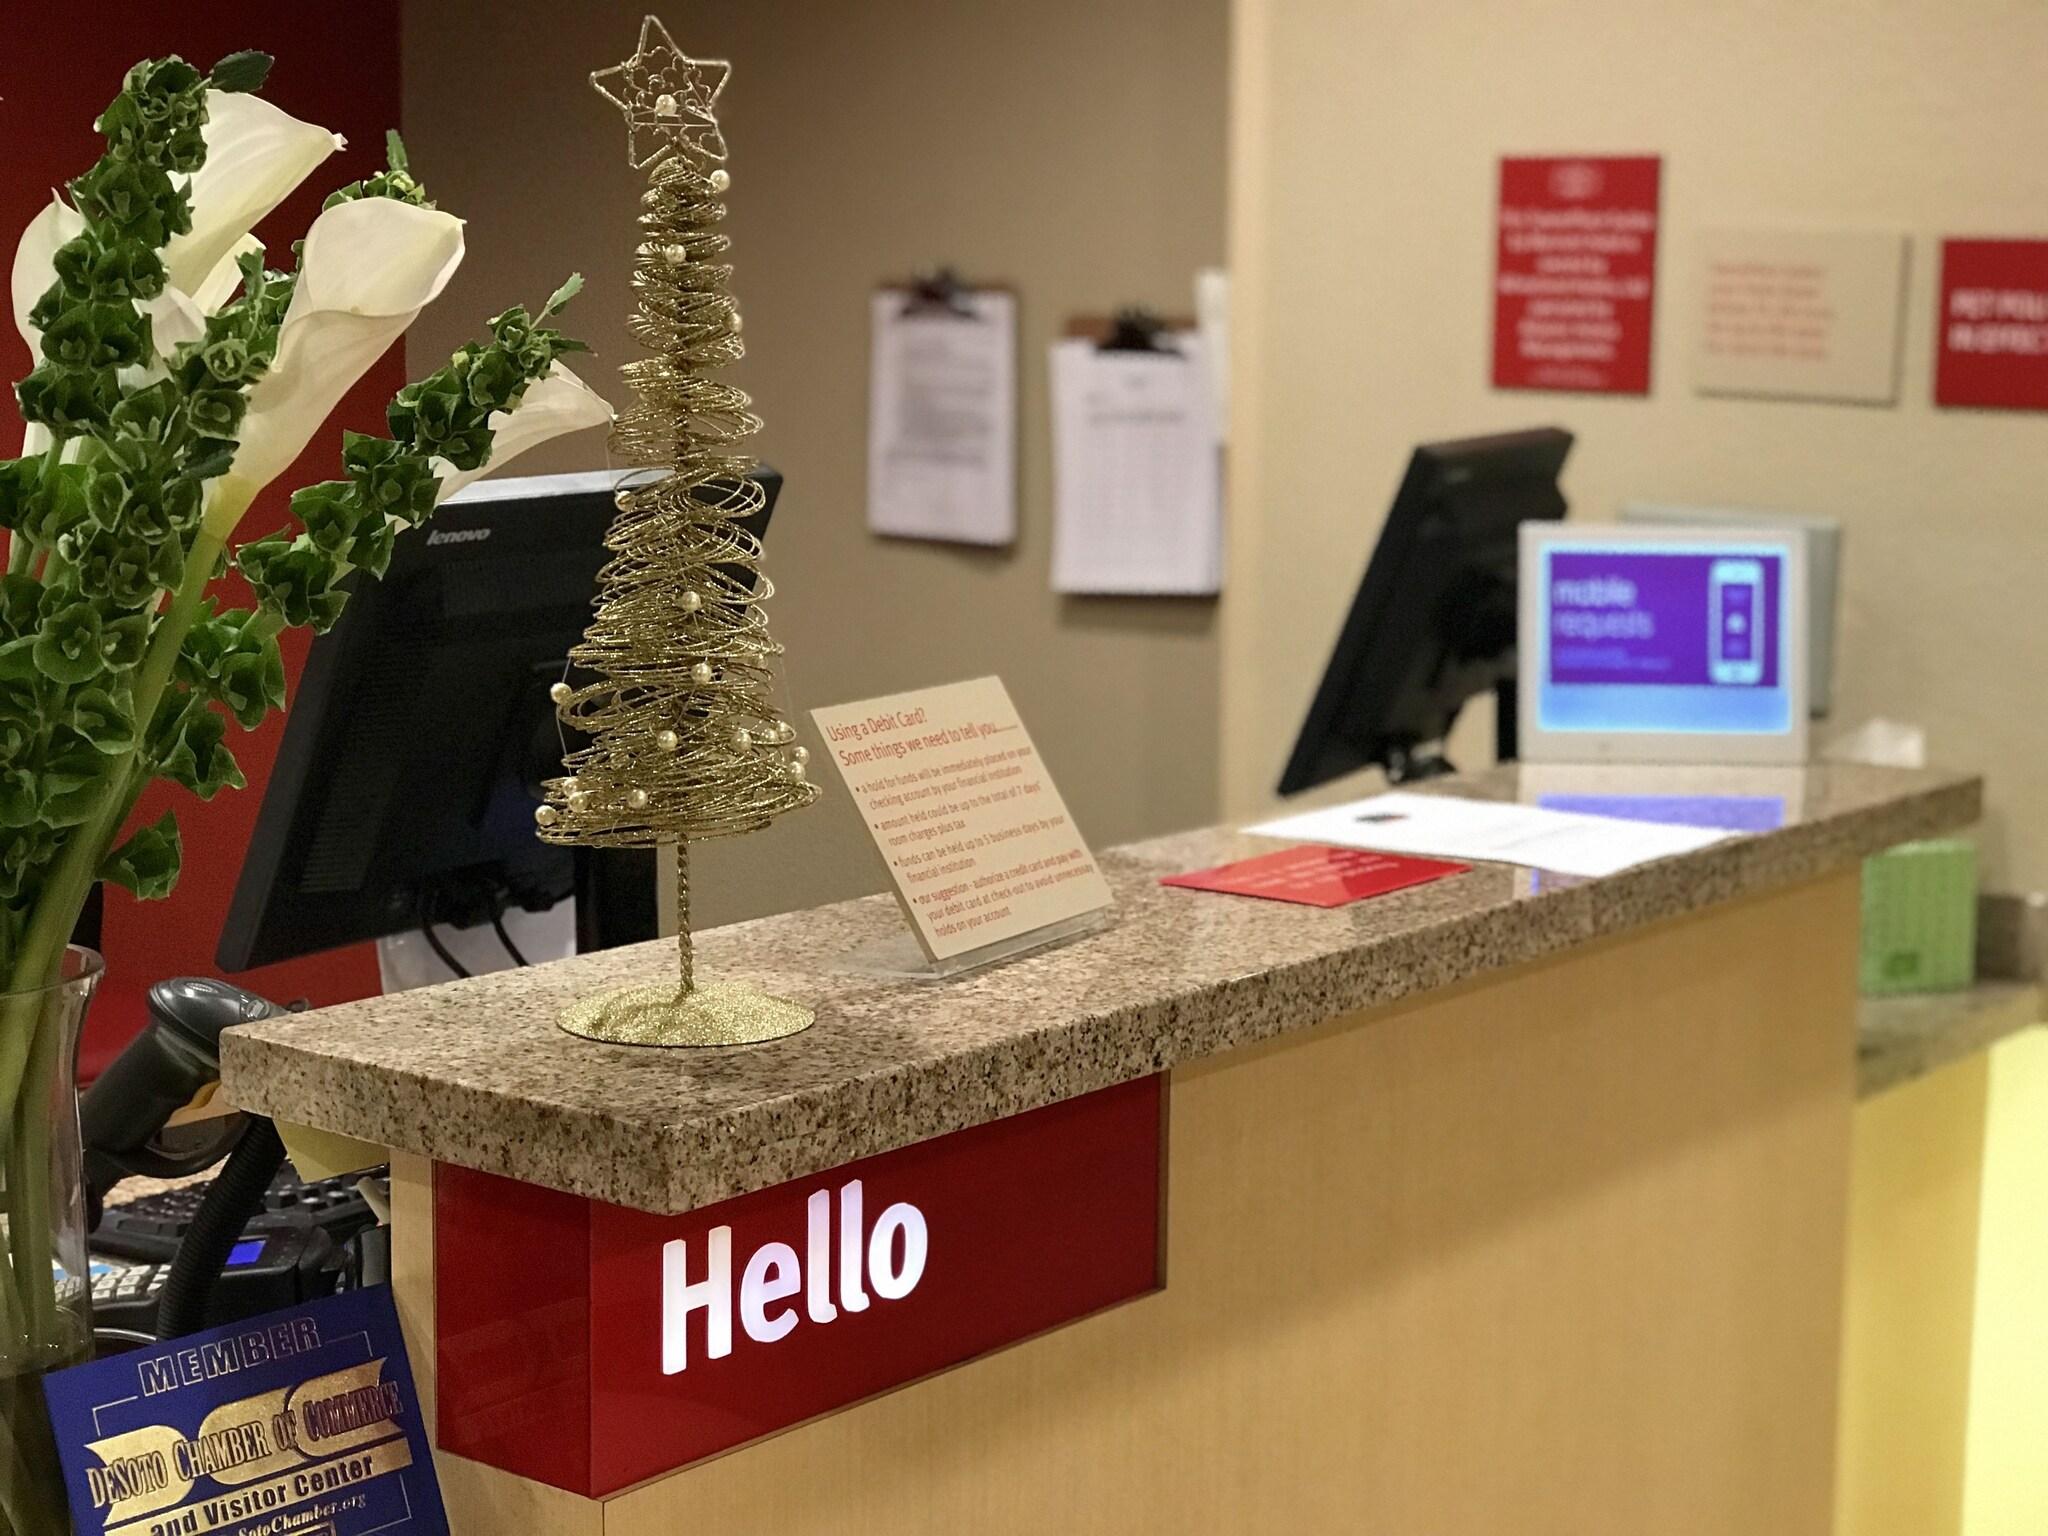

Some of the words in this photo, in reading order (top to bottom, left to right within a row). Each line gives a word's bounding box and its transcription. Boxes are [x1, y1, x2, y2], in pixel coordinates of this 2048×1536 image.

[426, 528, 491, 546] lenovo
[826, 724, 862, 742] Using
[860, 723, 870, 735] a
[867, 715, 898, 733] Debit
[896, 707, 927, 727] Card?
[839, 750, 873, 766] Some
[871, 742, 907, 759] things
[905, 738, 923, 751] we
[922, 731, 950, 747] need
[947, 730, 961, 742] to
[959, 723, 979, 740] tell
[866, 780, 886, 791] hold
[883, 777, 896, 788] for
[895, 773, 918, 785] funds
[930, 768, 942, 777] be
[984, 752, 1007, 765] placed
[1006, 750, 1017, 759] on
[1016, 747, 1031, 757] your
[870, 795, 904, 810] checking
[931, 786, 942, 795] by
[942, 782, 957, 794] your
[956, 773, 988, 787] financial
[988, 766, 1022, 780] institution
[881, 816, 910, 830] amount
[909, 811, 928, 822] held
[927, 805, 949, 819] could
[948, 804, 959, 813] be
[960, 801, 970, 811] up
[969, 799, 979, 808] to
[978, 796, 992, 805] the
[991, 791, 1009, 802] total
[888, 835, 908, 846] room
[909, 827, 938, 841] charges
[937, 823, 954, 835] plus
[953, 820, 966, 829] tax
[898, 855, 922, 867] funds
[921, 851, 935, 861] can
[935, 848, 947, 858] be
[946, 841, 965, 853] held
[965, 840, 976, 850] up
[974, 838, 985, 847] to
[989, 828, 1022, 843] business
[1022, 822, 1040, 834] days
[1038, 820, 1050, 829] by
[1049, 816, 1064, 827] your
[906, 867, 939, 883] financial
[940, 858, 976, 874] institution
[918, 894, 931, 905] our
[931, 884, 969, 901] suggestion
[973, 873, 1005, 889] authorize
[1009, 864, 1029, 878] credit
[1028, 860, 1044, 872] card
[1043, 856, 1057, 868] and
[1056, 855, 1069, 865] pay
[1068, 849, 1082, 860] with
[927, 909, 945, 923] your
[945, 902, 965, 916] debit
[965, 896, 983, 909] card
[982, 894, 991, 904] at
[1024, 882, 1035, 890] to
[1035, 875, 1054, 888] avoid
[935, 924, 957, 936] holds
[956, 921, 967, 931] on
[966, 916, 983, 929] your
[662, 1179, 928, 1375] Hello
[138, 1316, 321, 1397] MEMBER
[172, 1420, 271, 1481] CHAMBER
[272, 1409, 299, 1450] OF
[303, 1381, 405, 1442] COMMERCE
[151, 1510, 198, 1536] and
[203, 1484, 286, 1527] Visitor
[295, 1454, 374, 1496] Center
[236, 1494, 366, 1536] SotoChamber.org
